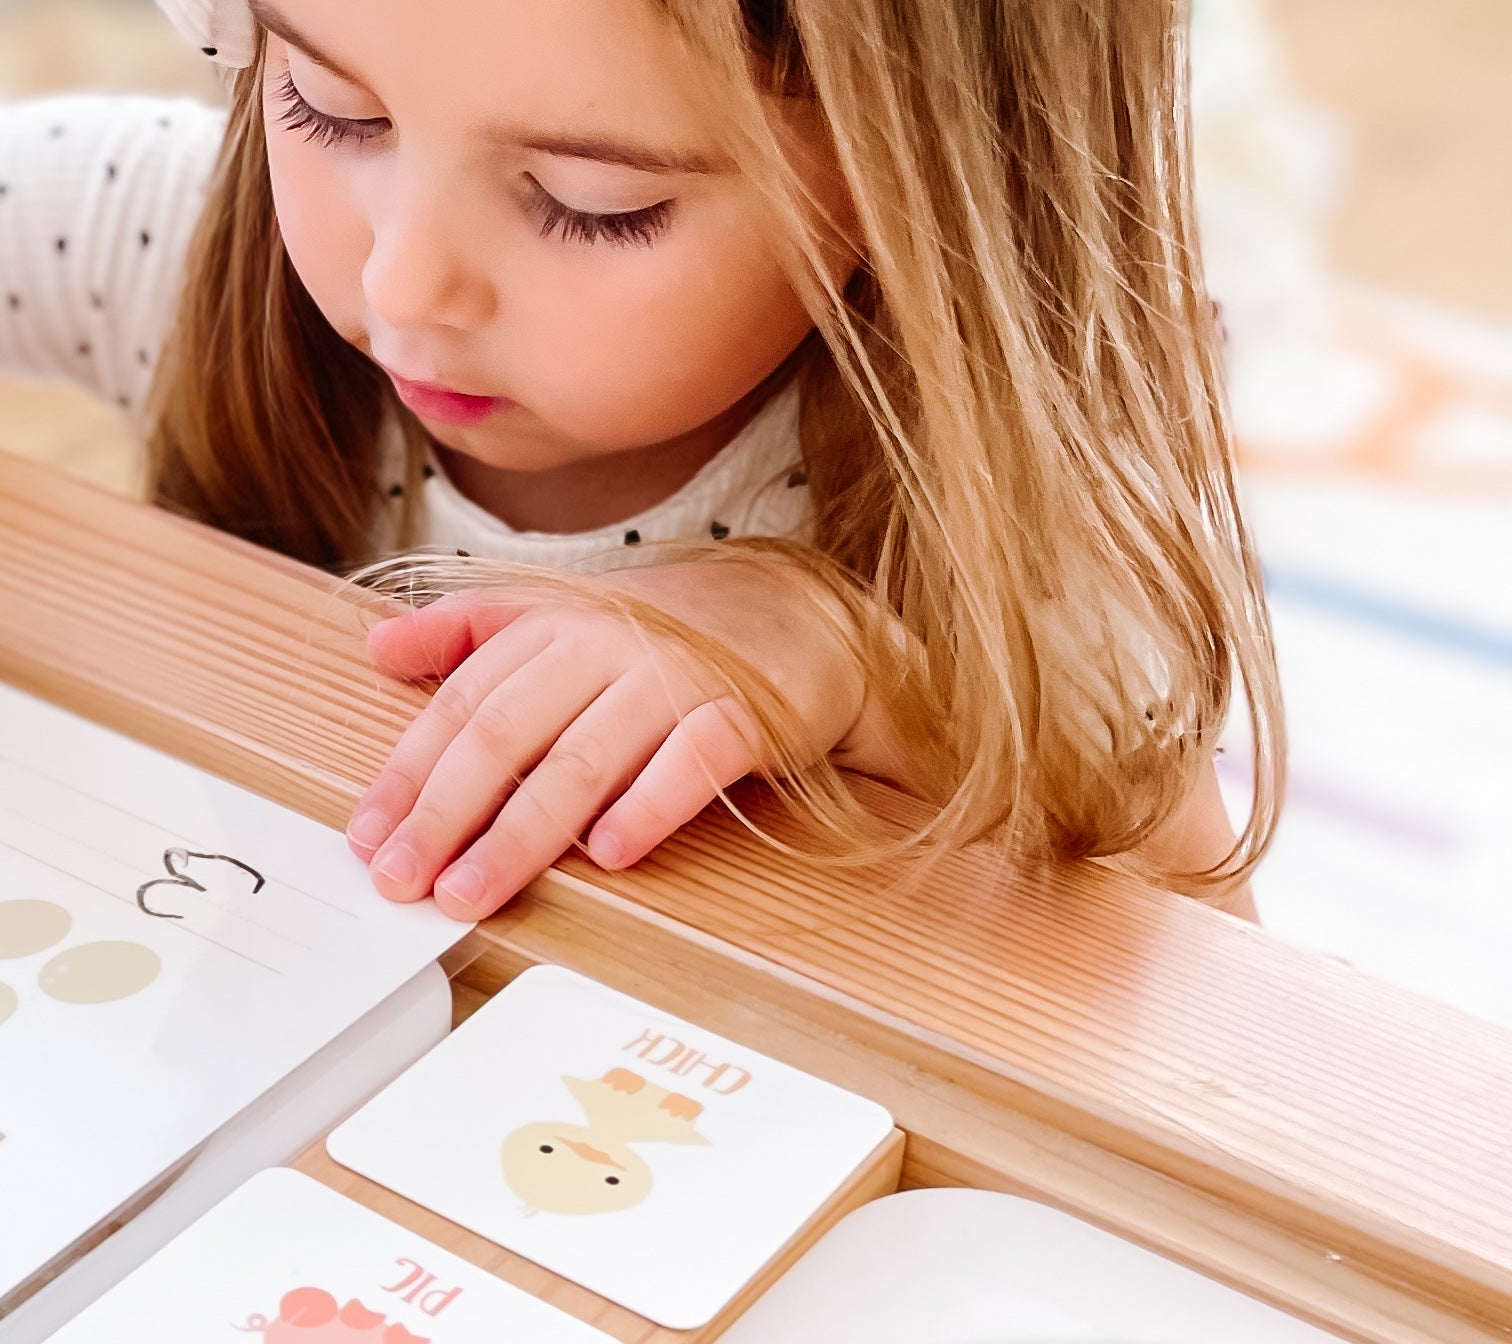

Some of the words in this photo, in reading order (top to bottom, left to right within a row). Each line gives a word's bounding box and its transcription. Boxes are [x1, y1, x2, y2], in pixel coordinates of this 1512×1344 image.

[136, 846, 266, 920] 3
[620, 1026, 754, 1096] CHICK
[377, 1256, 465, 1319] PIG
